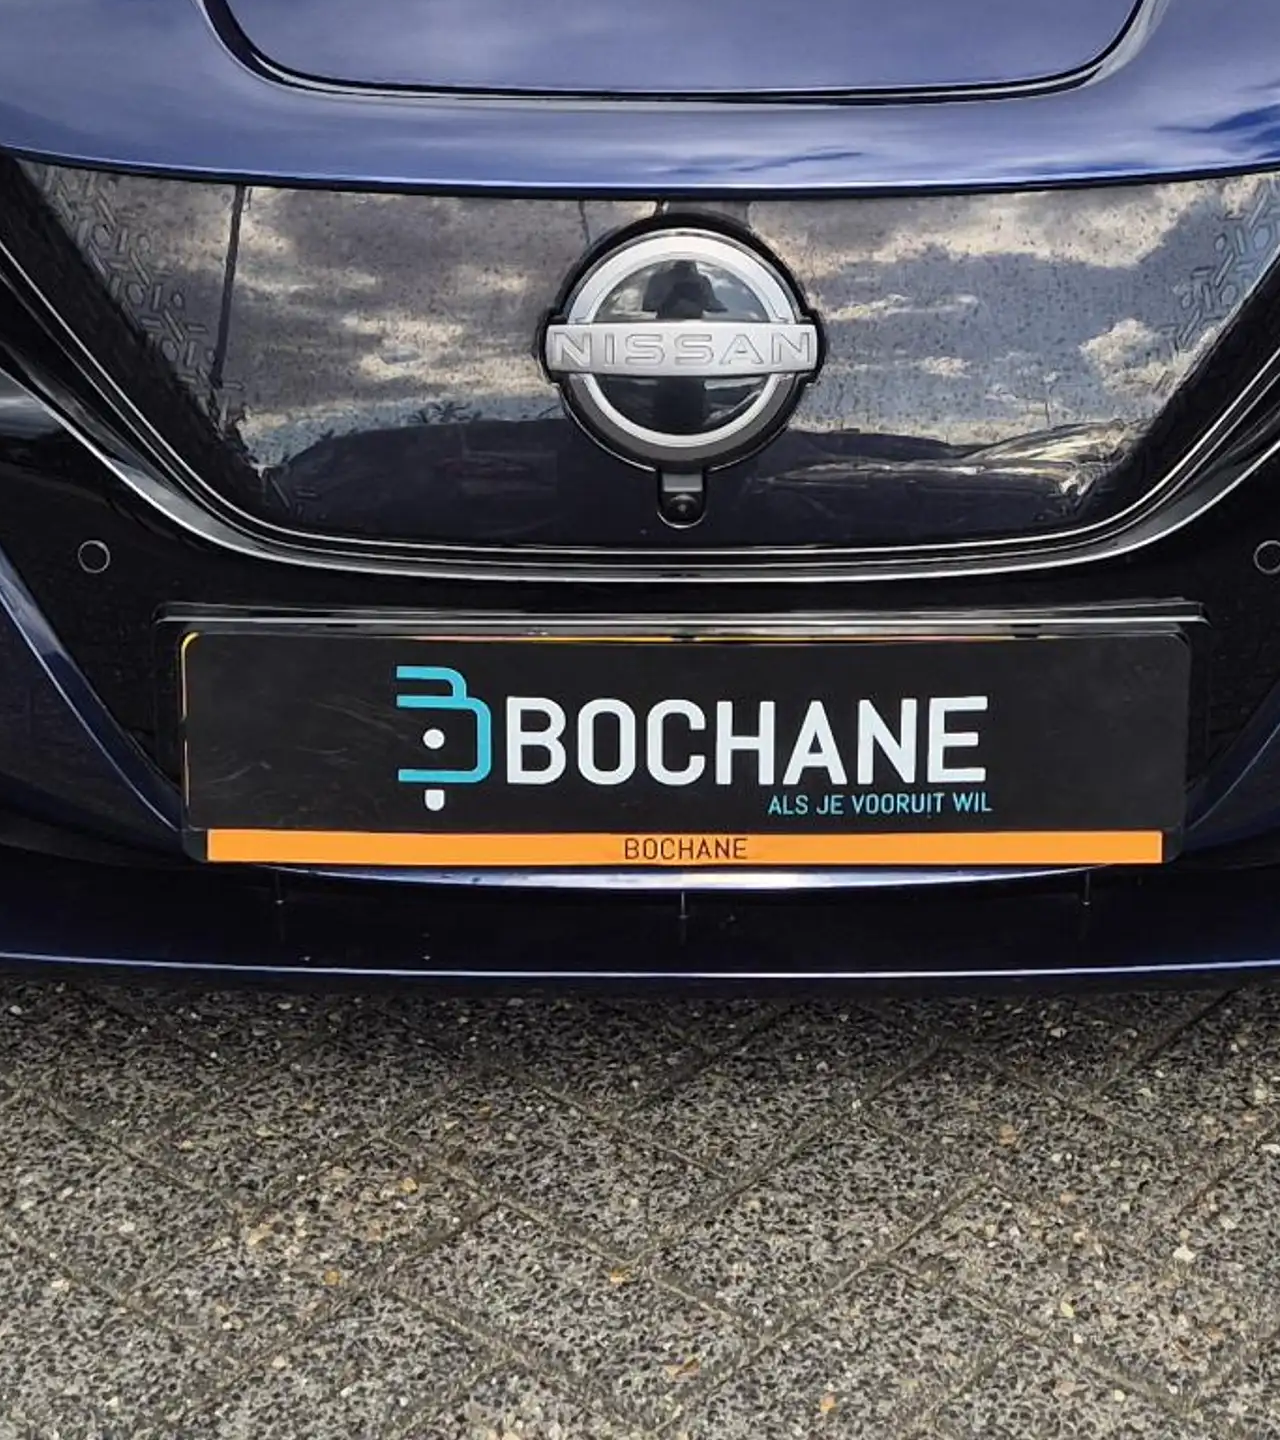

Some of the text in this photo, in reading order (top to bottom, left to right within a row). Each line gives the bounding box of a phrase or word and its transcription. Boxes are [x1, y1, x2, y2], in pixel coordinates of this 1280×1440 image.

[553, 331, 811, 368] NISSAN
[505, 695, 988, 787] BOCHANE
[768, 790, 992, 815] ALS JE VOORUIT WIL
[624, 837, 747, 861] BOCHANE
